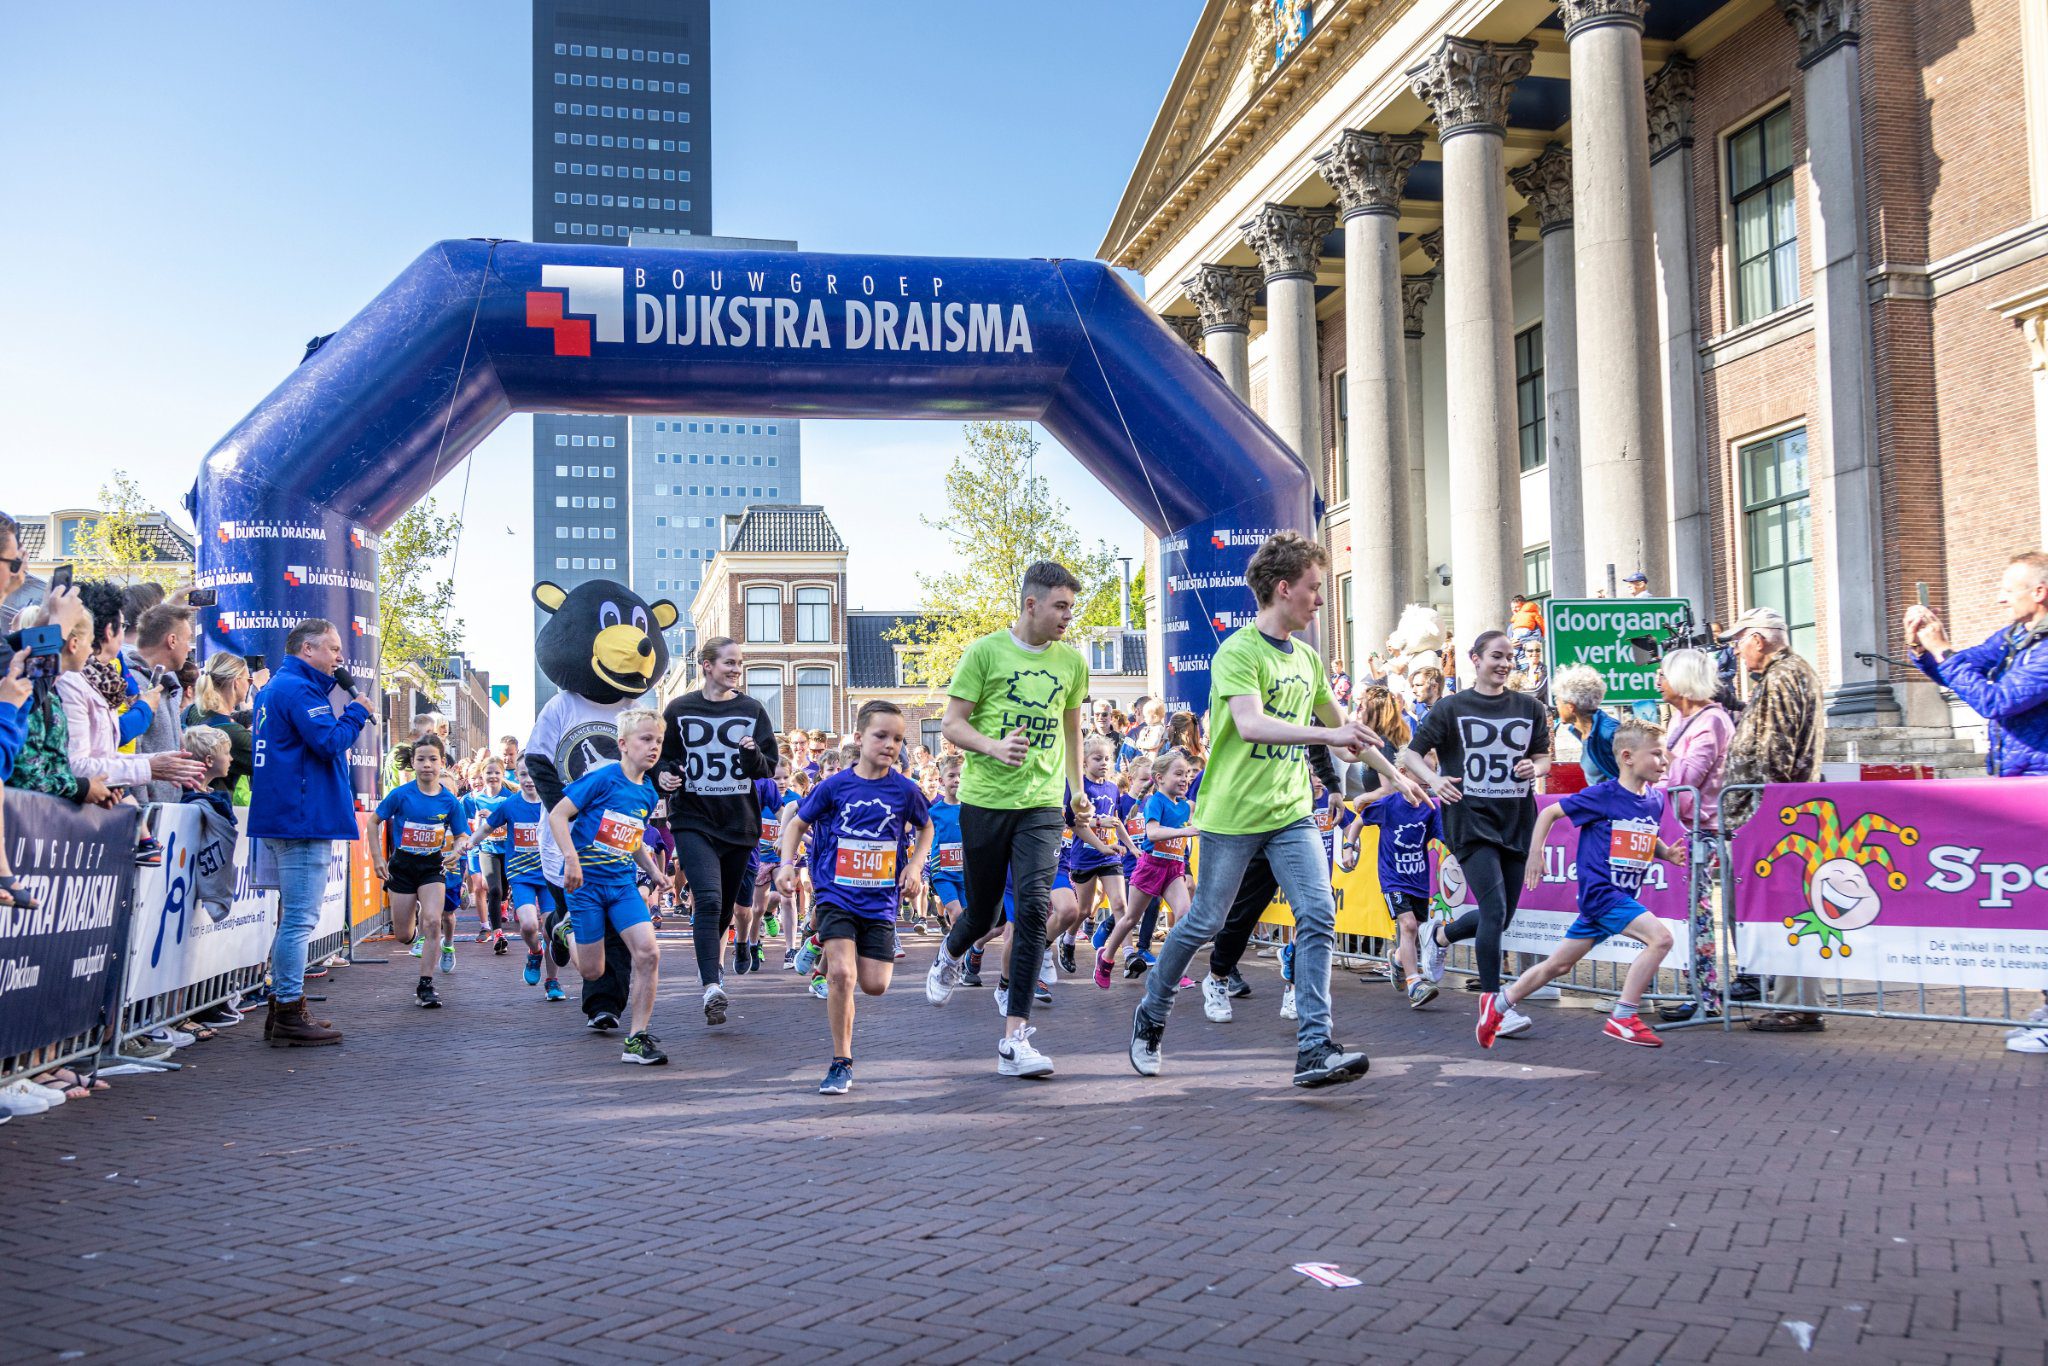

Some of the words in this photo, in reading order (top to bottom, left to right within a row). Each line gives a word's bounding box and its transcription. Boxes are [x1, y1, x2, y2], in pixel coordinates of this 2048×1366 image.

[636, 268, 943, 298] BOUWGROEP
[636, 293, 831, 348] DIJKSTRA
[846, 300, 1033, 353] DRAISMA
[236, 526, 279, 538] DIJKSTRA
[281, 527, 327, 541] DRAISMA
[309, 573, 349, 588] DIJKSTRA
[1209, 576, 1248, 588] DRAISMA
[236, 617, 280, 630] DIJKSTRA
[1003, 712, 1059, 731] LOOP
[570, 725, 592, 741] DANCE
[681, 718, 752, 749] DC
[1461, 719, 1531, 751] DC
[412, 830, 437, 843] 5083
[524, 829, 538, 842] 50
[1630, 833, 1652, 853] 5151
[853, 851, 883, 871] 5140
[1396, 860, 1426, 875] LWD
[56, 875, 118, 934] DRAISMA
[1929, 940, 1946, 952] Dé
[1950, 942, 1989, 953] winkel
[1993, 943, 2005, 953] in
[2009, 943, 2030, 954] het
[1887, 953, 1898, 963] in
[1901, 954, 1921, 965] het
[1925, 955, 1951, 966] hart
[1955, 957, 1976, 967] van
[1980, 957, 1996, 968] de
